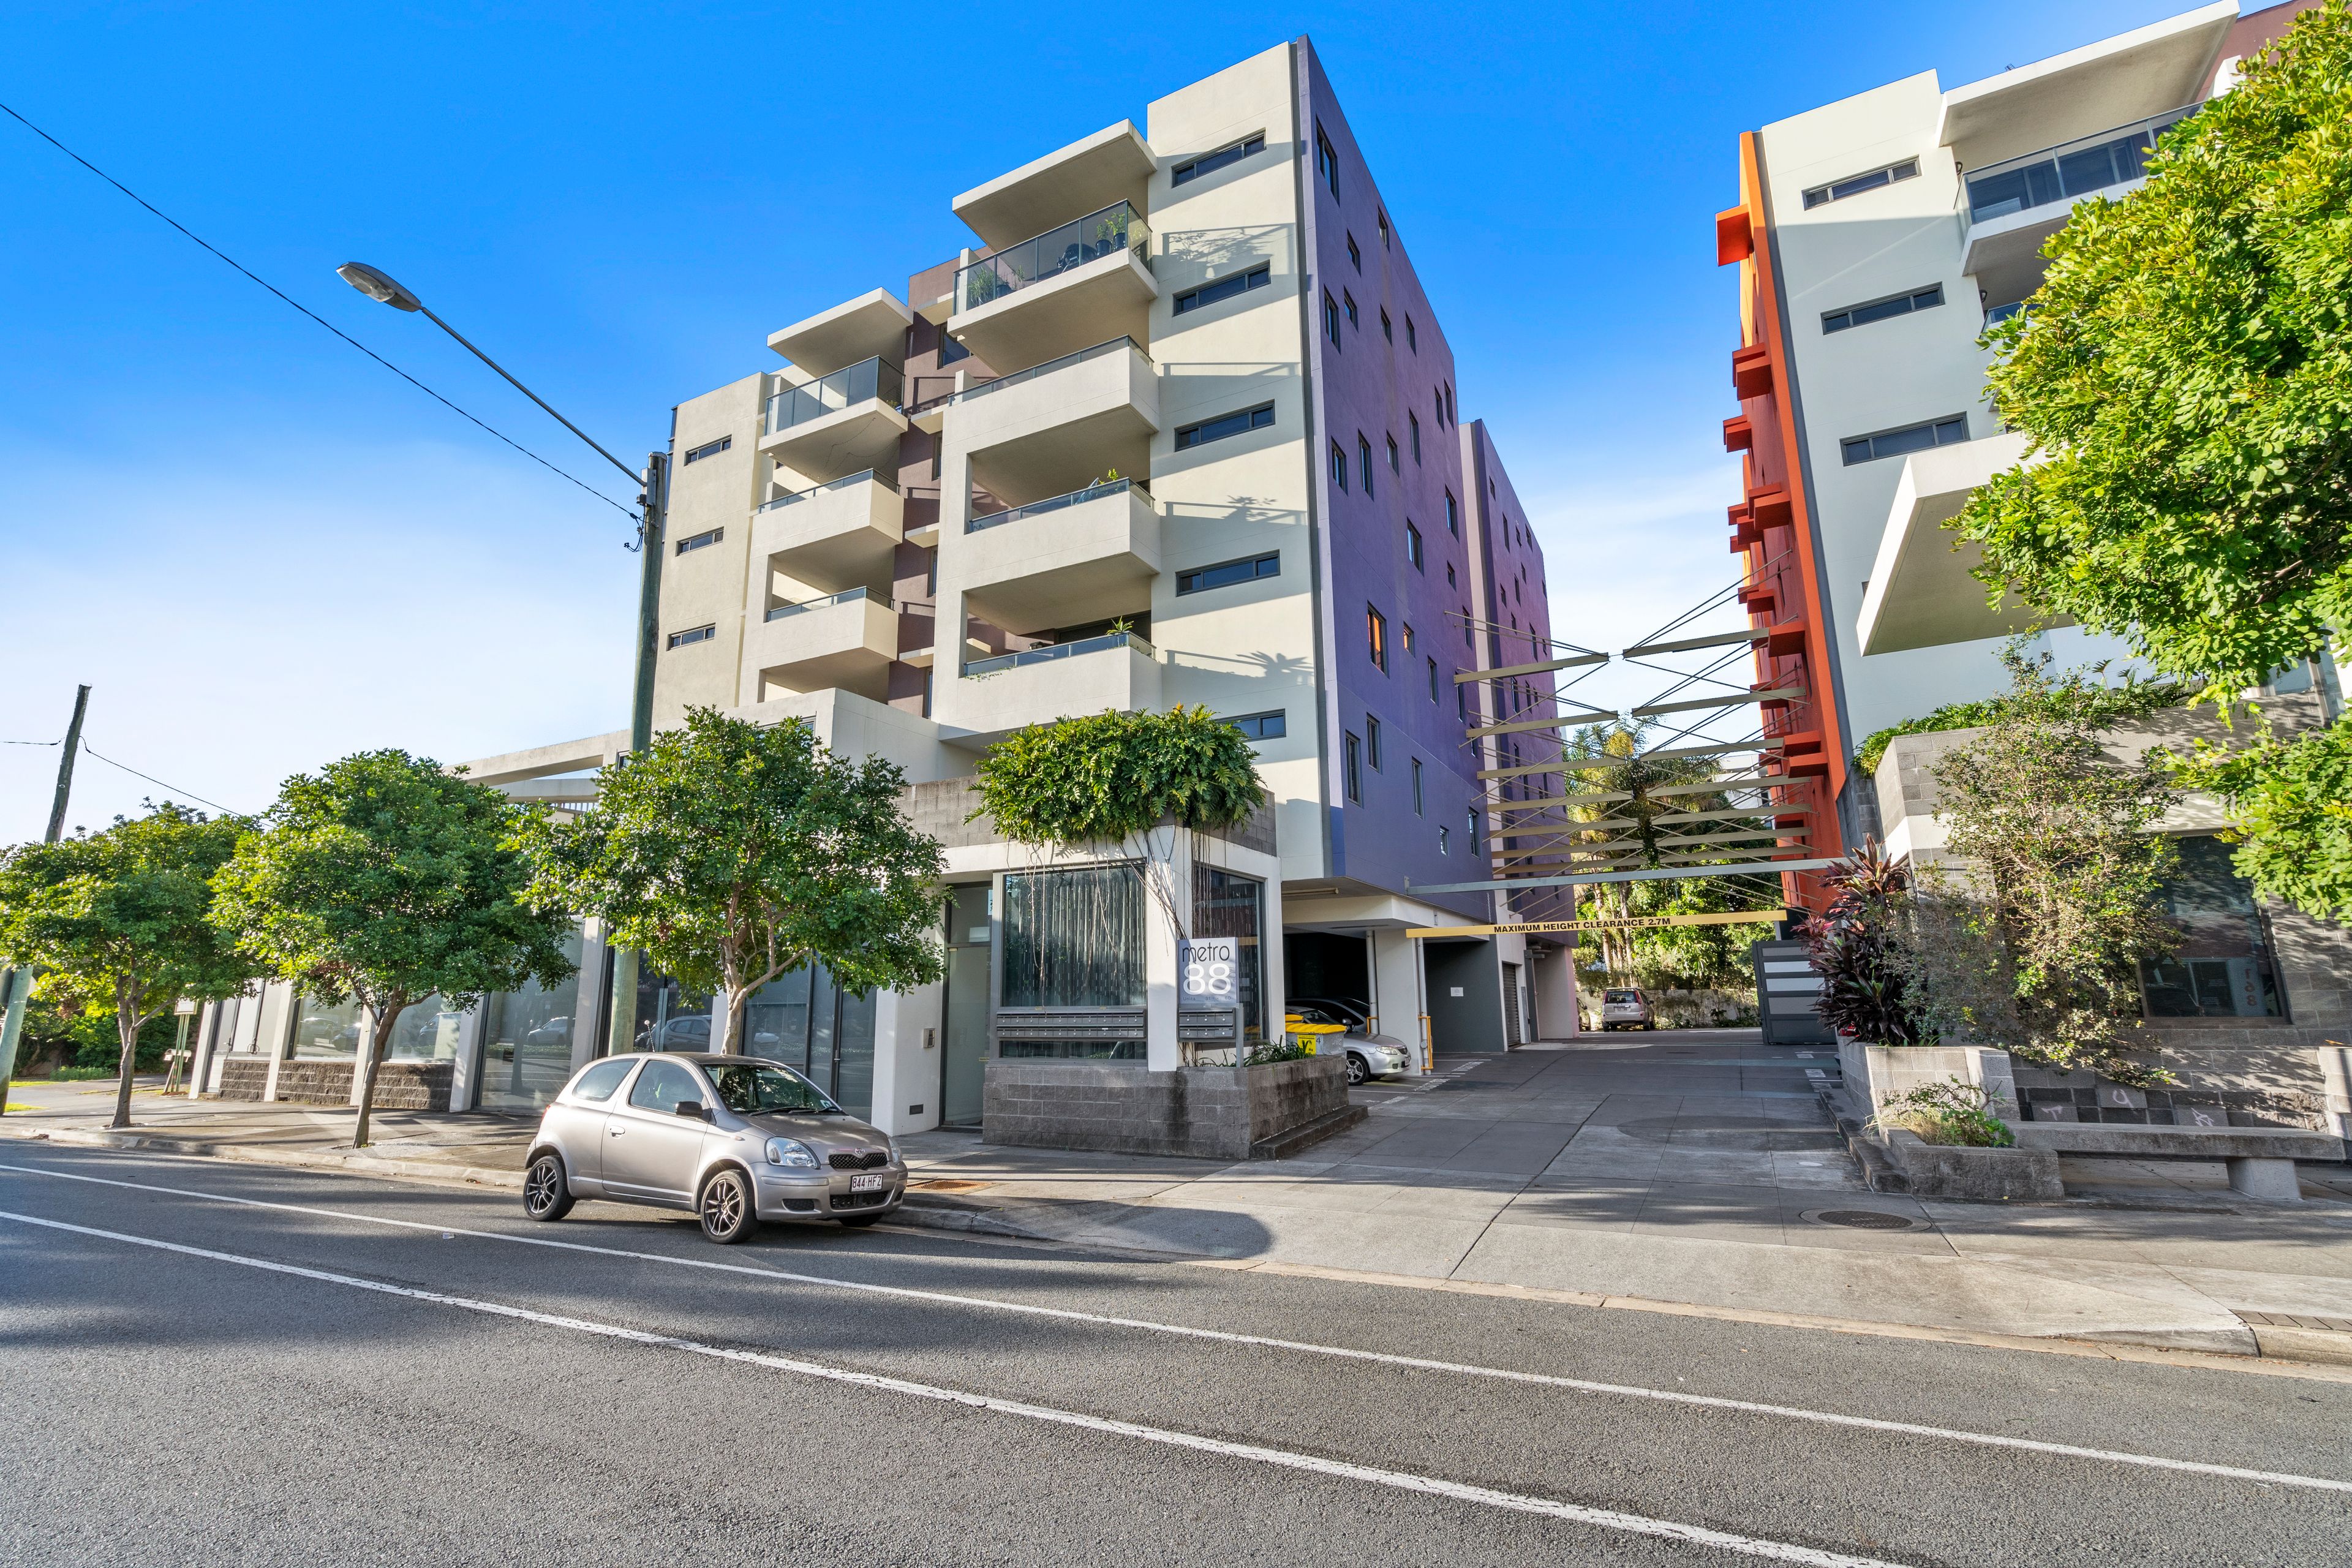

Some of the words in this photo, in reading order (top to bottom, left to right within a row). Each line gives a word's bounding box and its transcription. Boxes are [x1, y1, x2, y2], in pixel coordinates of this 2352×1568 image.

[1543, 922, 1580, 930] HEIGHT
[1583, 919, 1645, 929] CLEARANCE
[1182, 942, 1230, 962] metro
[1183, 963, 1231, 995] 88
